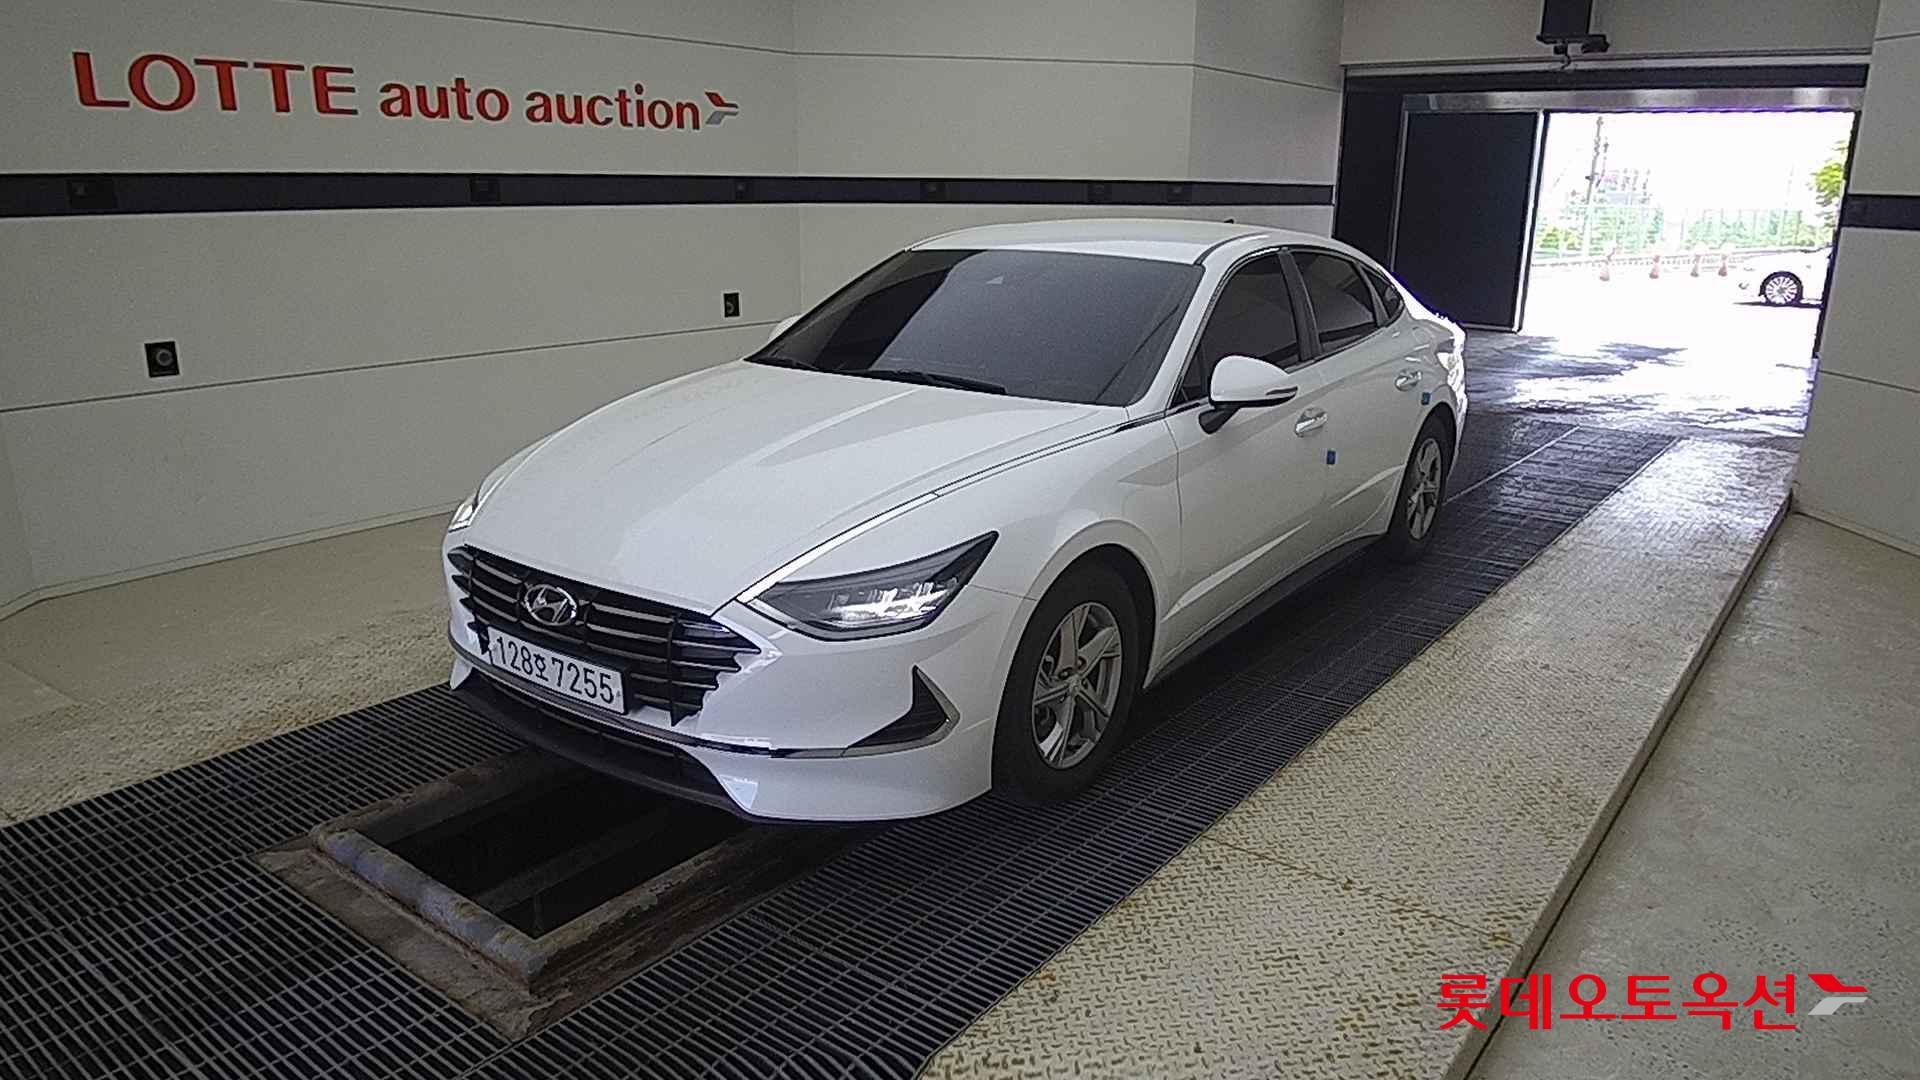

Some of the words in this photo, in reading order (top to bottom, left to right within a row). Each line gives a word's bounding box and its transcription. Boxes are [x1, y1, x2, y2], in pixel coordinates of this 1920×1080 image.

[72, 51, 359, 116] LOTTE
[379, 77, 509, 122] auto
[525, 84, 701, 130] auction
[497, 637, 614, 704] 128호7255
